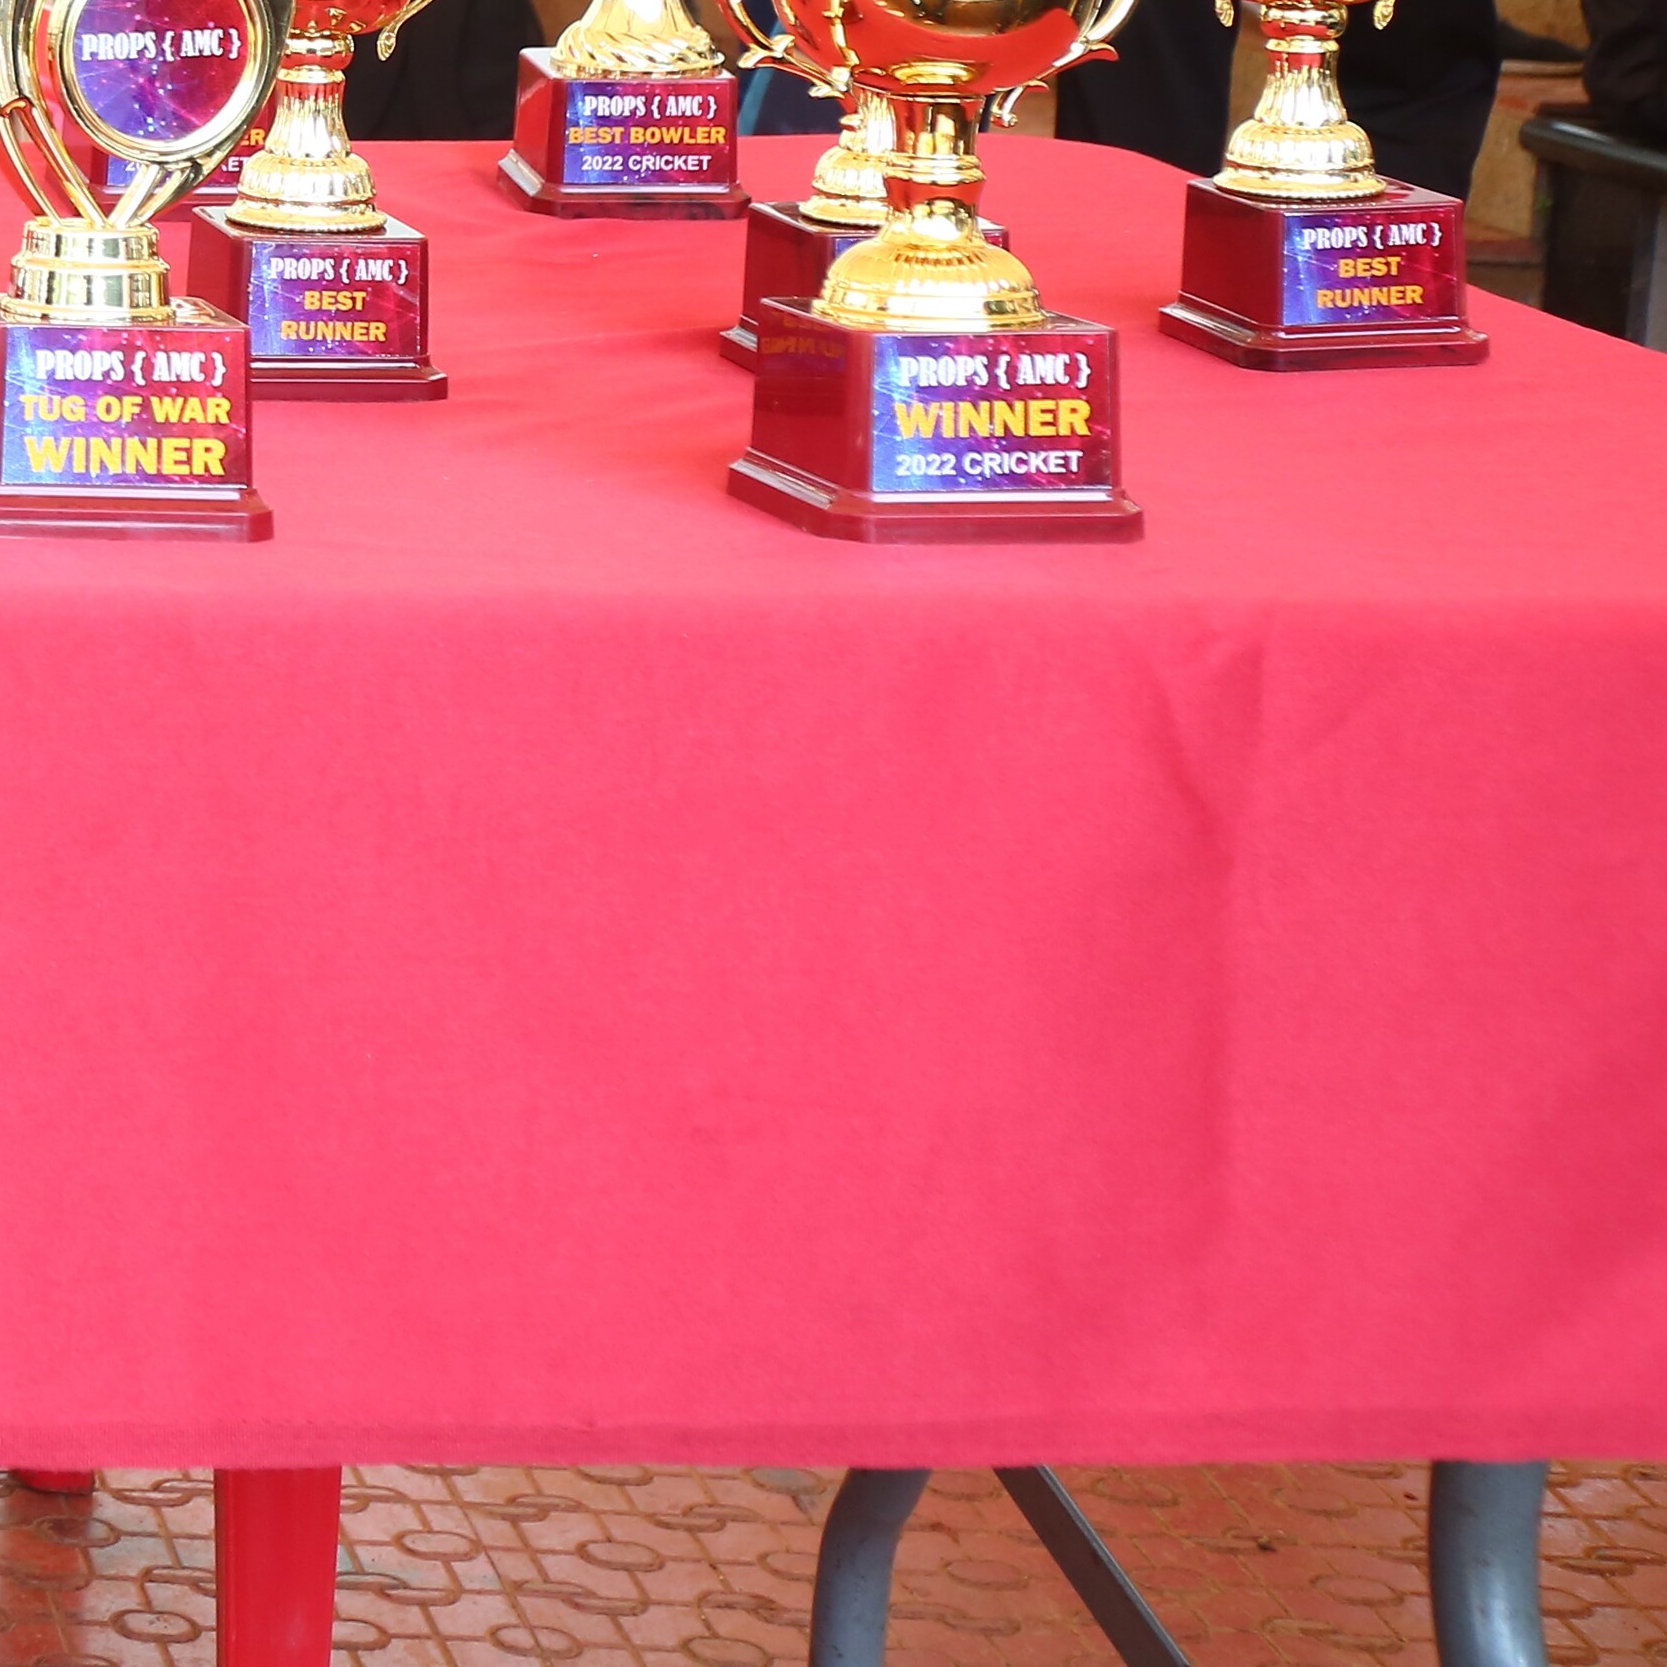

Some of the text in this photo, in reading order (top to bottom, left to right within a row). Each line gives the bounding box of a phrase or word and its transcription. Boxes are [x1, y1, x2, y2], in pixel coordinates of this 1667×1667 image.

[82, 33, 156, 61] PROPS
[180, 29, 225, 58] AMC
[583, 96, 647, 116] PROPS
[666, 96, 703, 116] AMC
[568, 126, 726, 144] BEST BOWLER
[581, 154, 712, 172] 2022 CRICKET
[1303, 226, 1368, 249] PROPS
[1388, 224, 1427, 247] AMC
[270, 258, 335, 282] PROPS
[355, 258, 394, 282] AMC
[1338, 256, 1401, 278] BEST
[304, 291, 366, 311] BEST
[1315, 285, 1424, 309] RUNNER
[280, 320, 387, 342] RUNNER
[36, 351, 125, 381] PROPS
[152, 352, 206, 382] AMC
[900, 355, 989, 387] PROPS
[1016, 353, 1070, 384] AMC
[21, 393, 231, 424] TUG OF WAR
[894, 399, 1091, 439] WINNER
[24, 435, 227, 476] WINNER
[896, 449, 1083, 479] 2022 CRICKET
